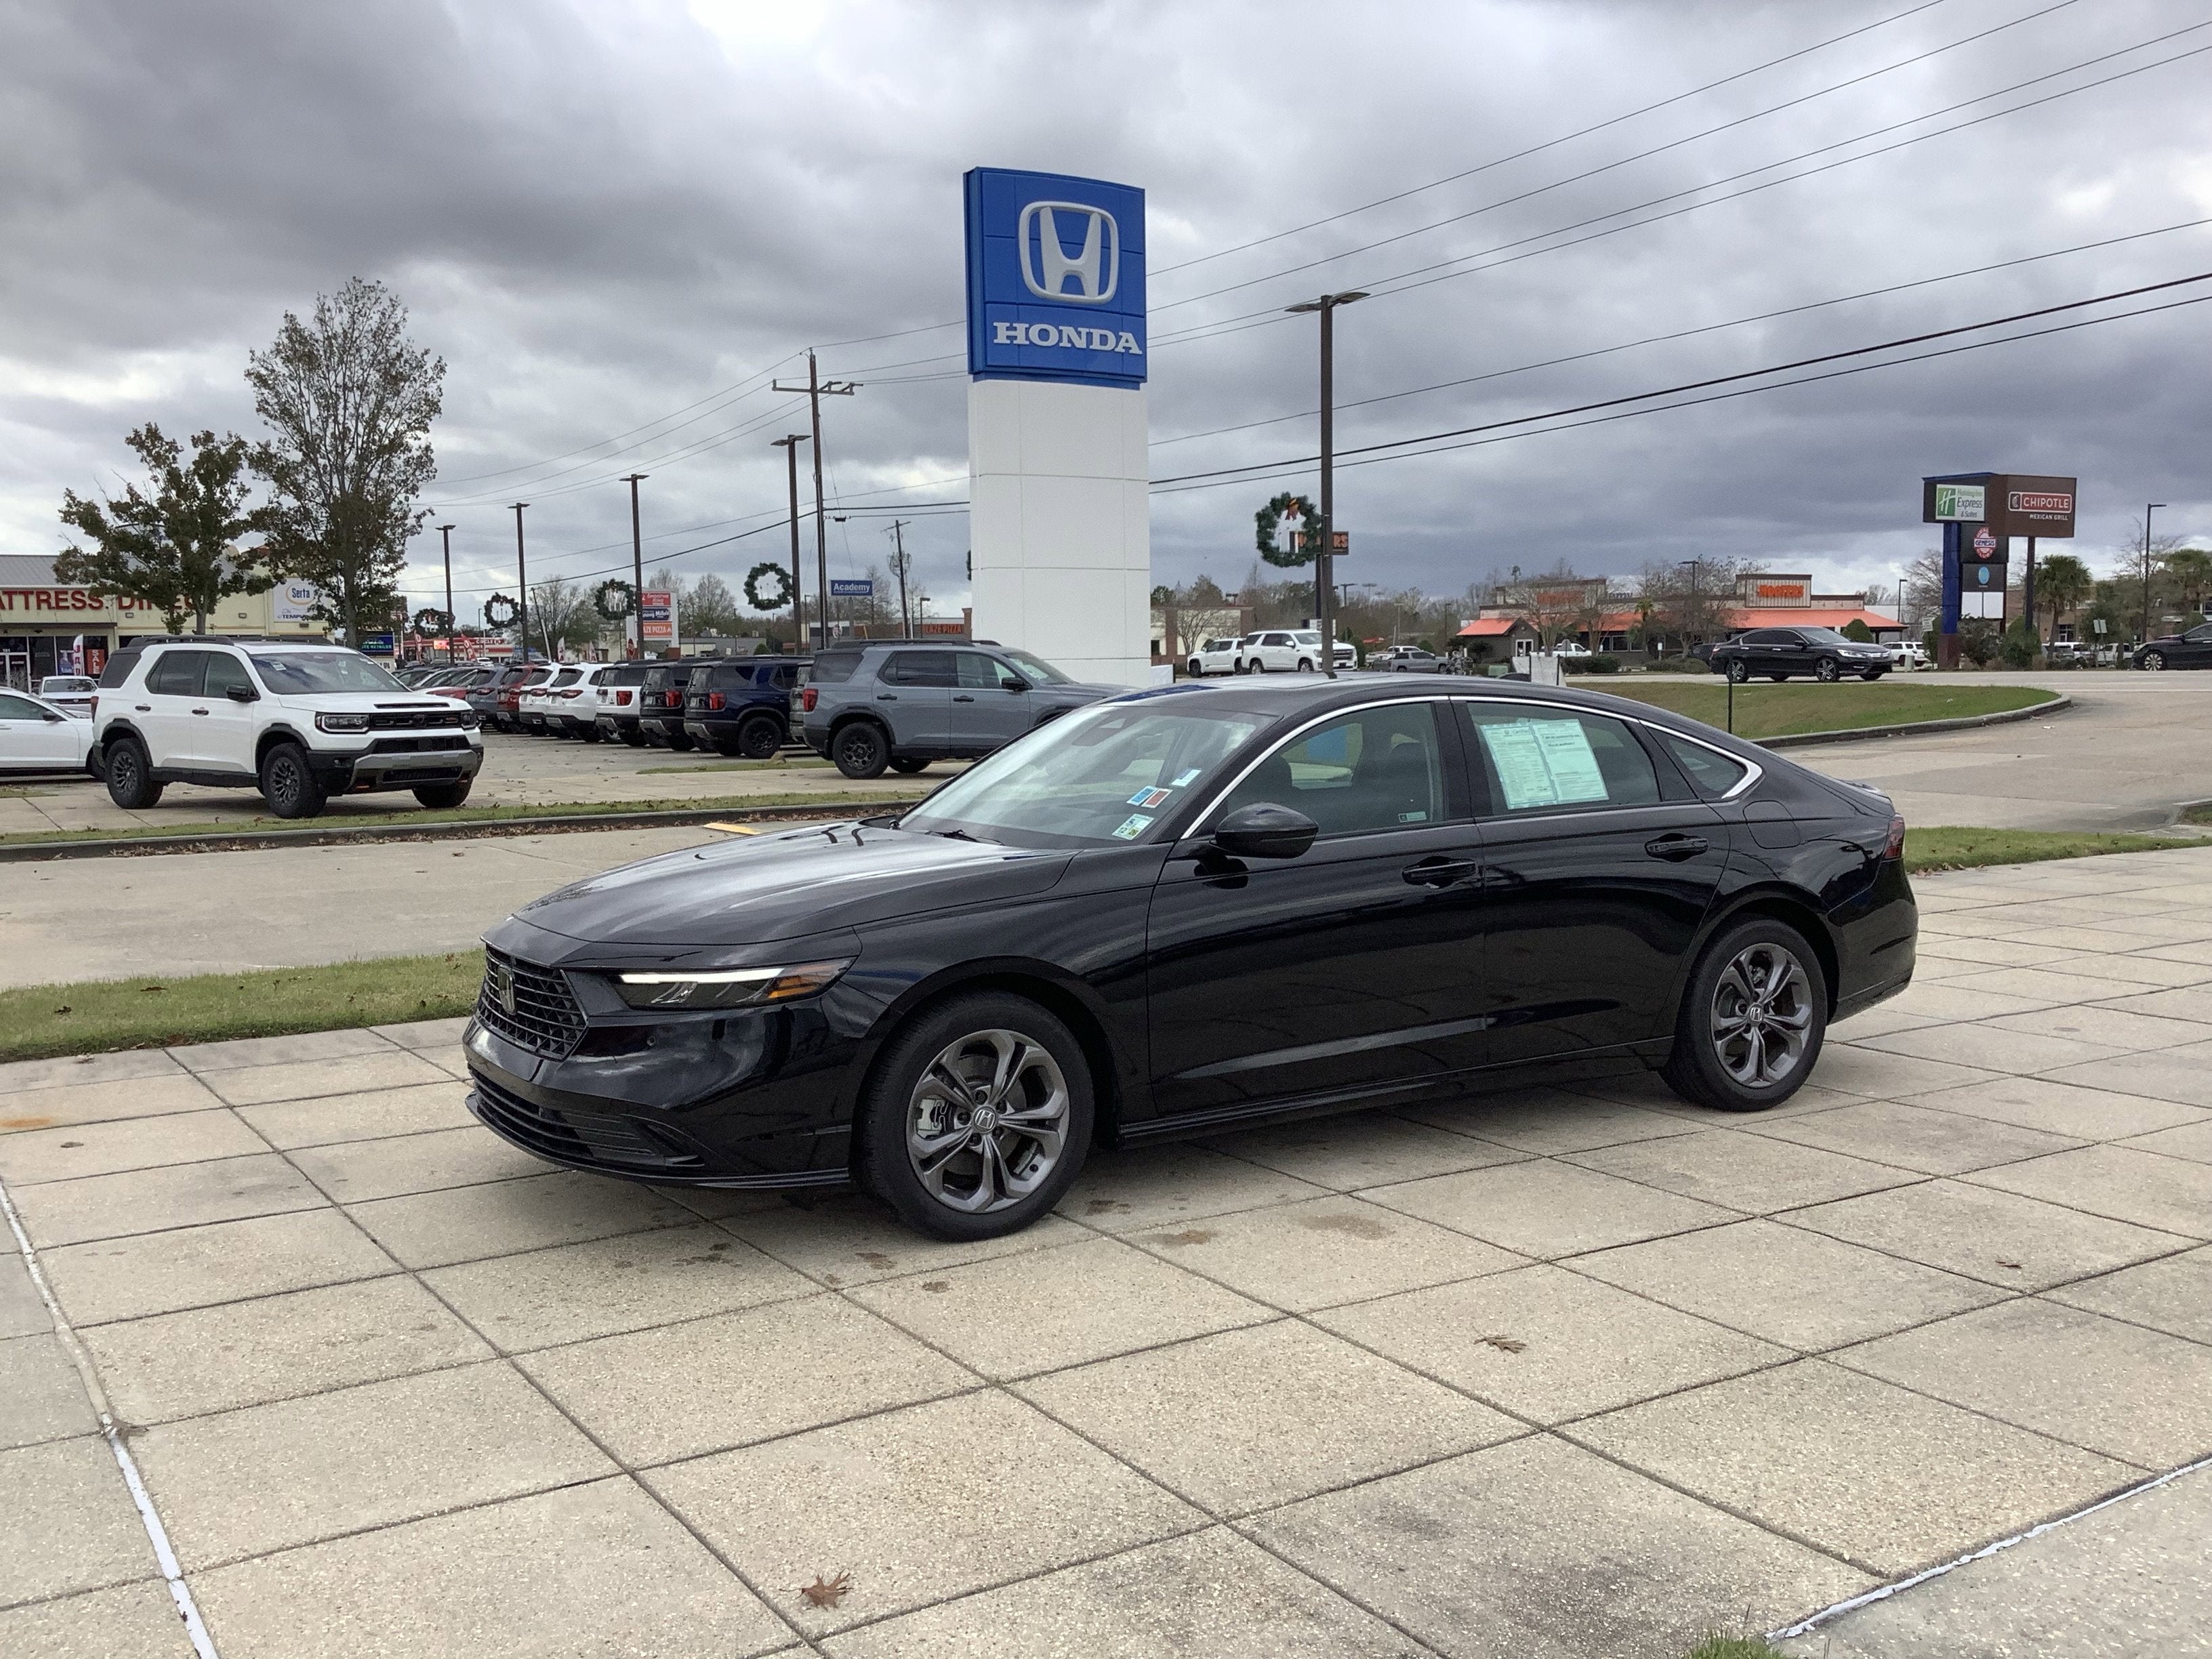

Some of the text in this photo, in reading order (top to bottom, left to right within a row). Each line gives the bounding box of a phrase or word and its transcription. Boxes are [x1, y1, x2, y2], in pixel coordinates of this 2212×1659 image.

[993, 321, 1143, 355] HONDA
[1957, 497, 1982, 510] Express
[2023, 497, 2069, 508] CHIPOTLE
[292, 588, 310, 598] Serta
[834, 583, 870, 593] Academy
[652, 626, 666, 634] PIZZA
[91, 649, 100, 674] SALE
